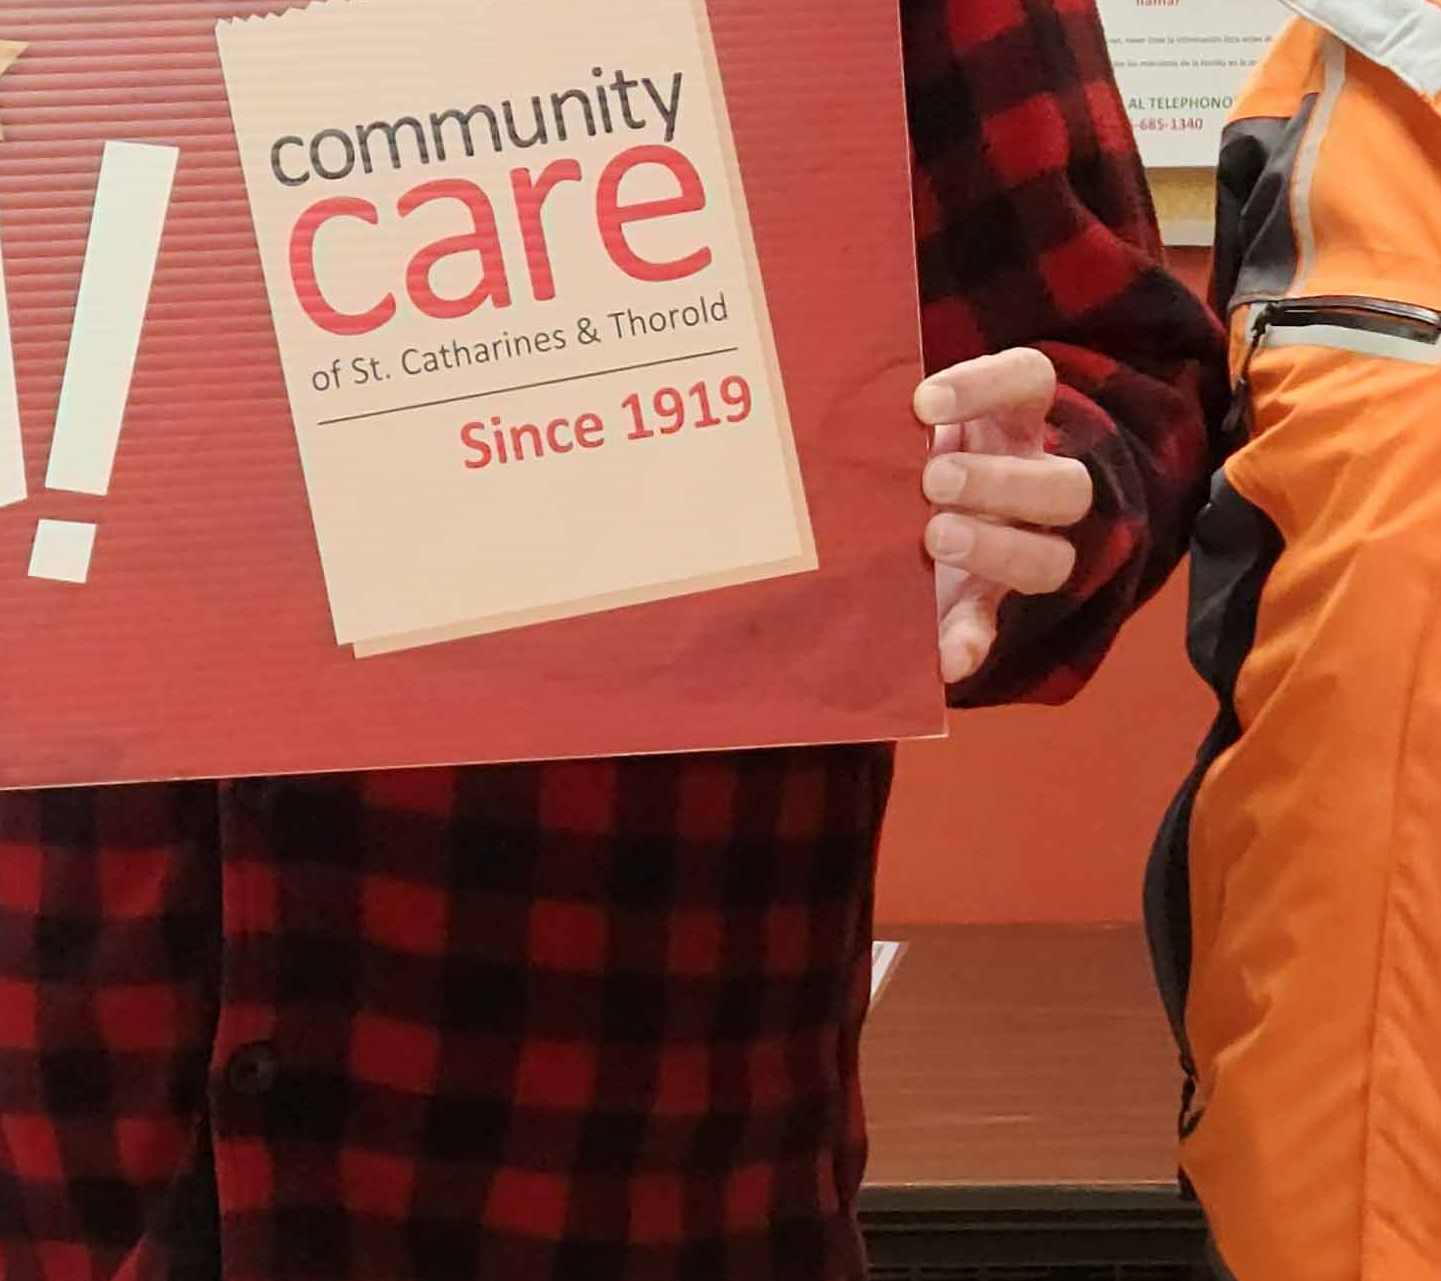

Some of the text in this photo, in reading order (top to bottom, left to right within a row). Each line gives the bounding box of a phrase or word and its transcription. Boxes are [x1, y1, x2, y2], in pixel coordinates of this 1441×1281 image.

[269, 66, 684, 187] community
[1128, 97, 1145, 110] AL
[1135, 118, 1203, 131] -685-1340
[288, 143, 713, 337] care
[311, 292, 729, 393] of St. Catharines & Thorold
[459, 373, 754, 471] Since 1919
